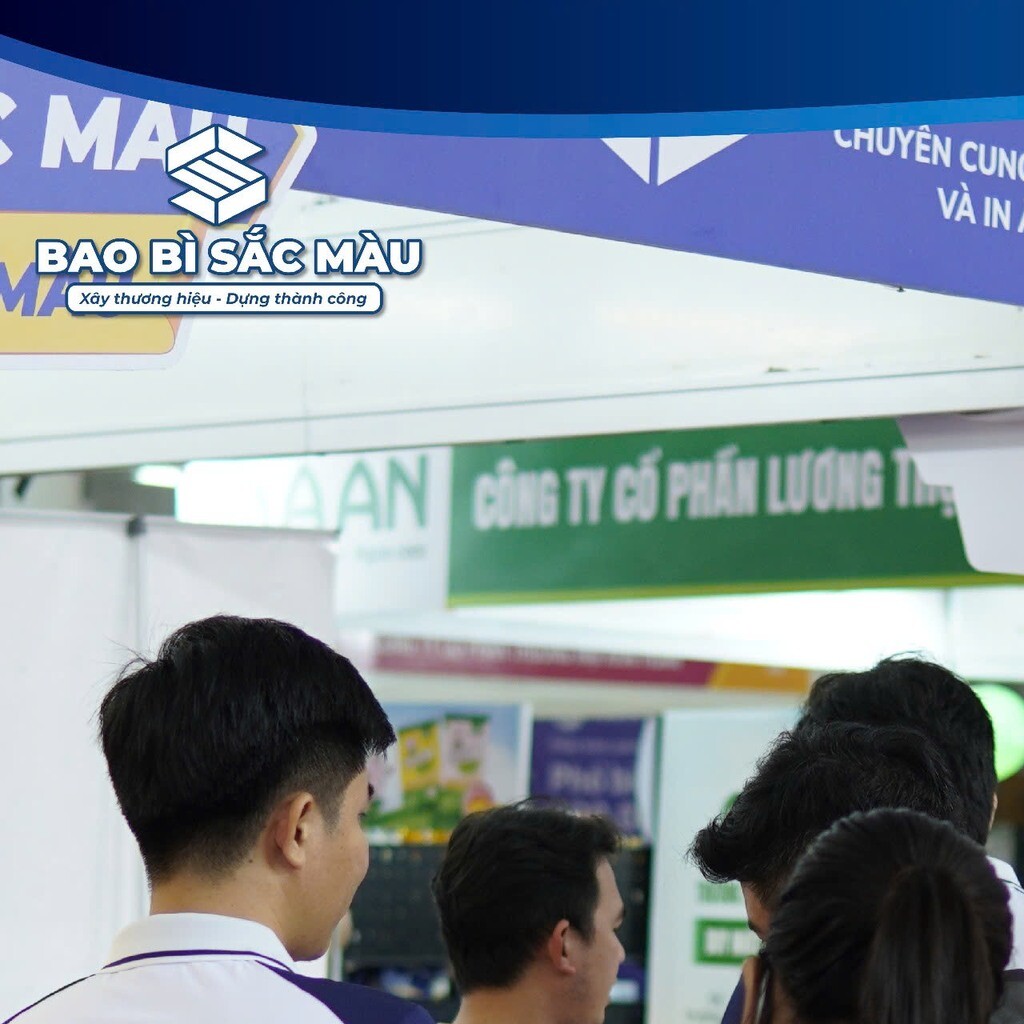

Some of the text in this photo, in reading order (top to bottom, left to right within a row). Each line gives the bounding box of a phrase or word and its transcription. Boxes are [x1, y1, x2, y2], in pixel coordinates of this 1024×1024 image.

[834, 125, 951, 168] CHUYÊN
[937, 182, 977, 225] VÀ
[984, 196, 1012, 230] IN
[474, 457, 558, 531] CÔNG
[567, 466, 608, 526] TY
[767, 446, 884, 515] LƯƠNG
